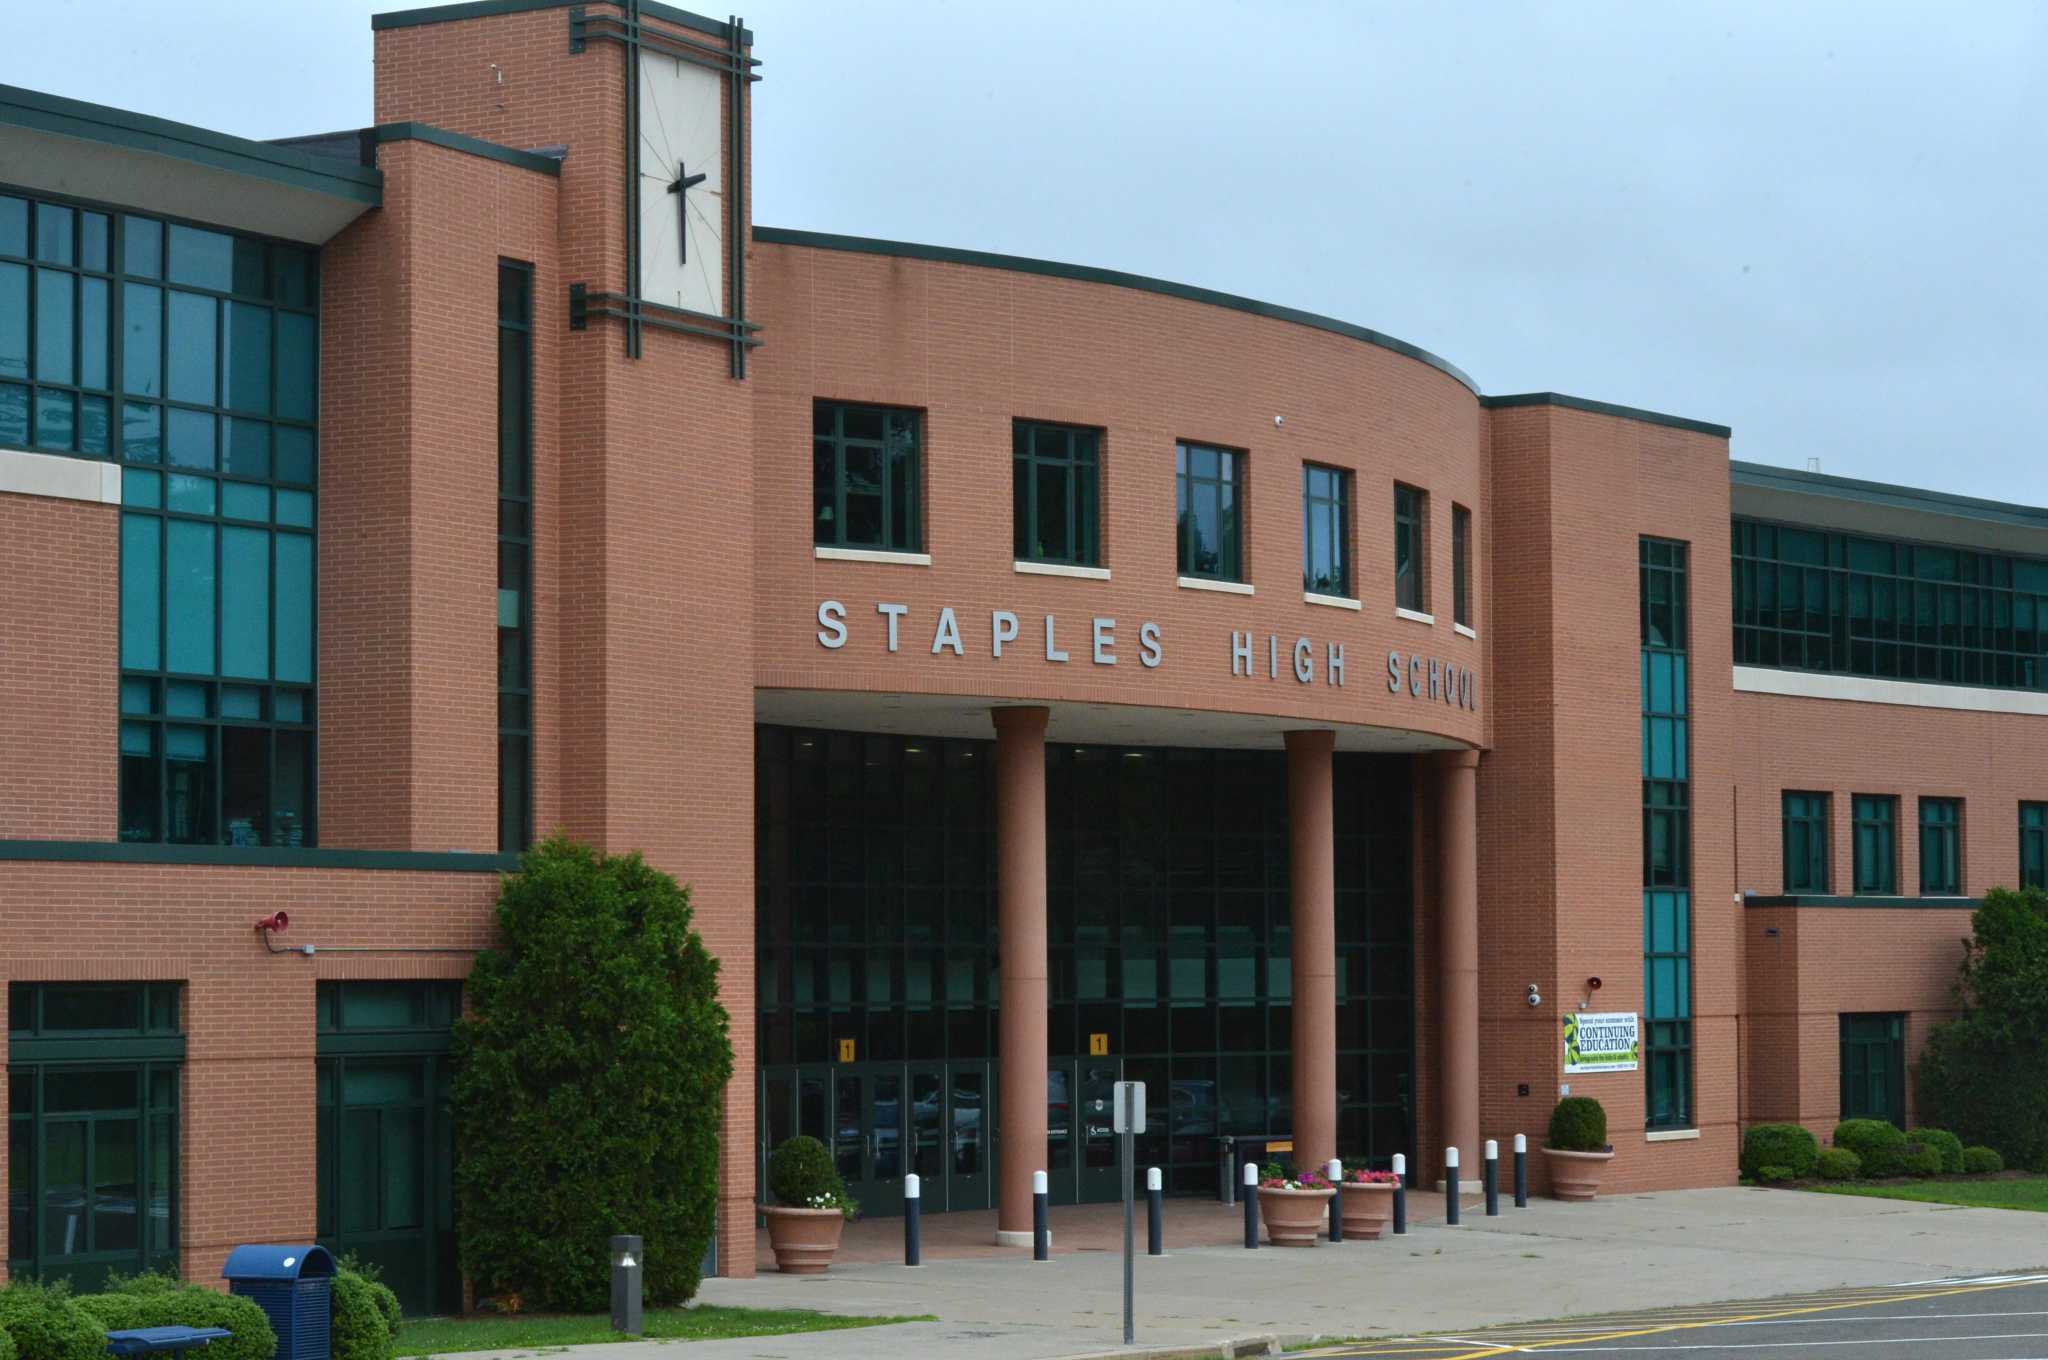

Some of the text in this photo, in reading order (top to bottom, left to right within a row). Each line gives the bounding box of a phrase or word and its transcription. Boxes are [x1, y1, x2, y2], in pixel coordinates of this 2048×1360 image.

[816, 600, 1476, 711] STAPLES HIGH SCHOOL
[1579, 1026, 1635, 1039] CONTINUING
[1096, 1037, 1102, 1051] 1
[1580, 1038, 1630, 1052] EDUCATION
